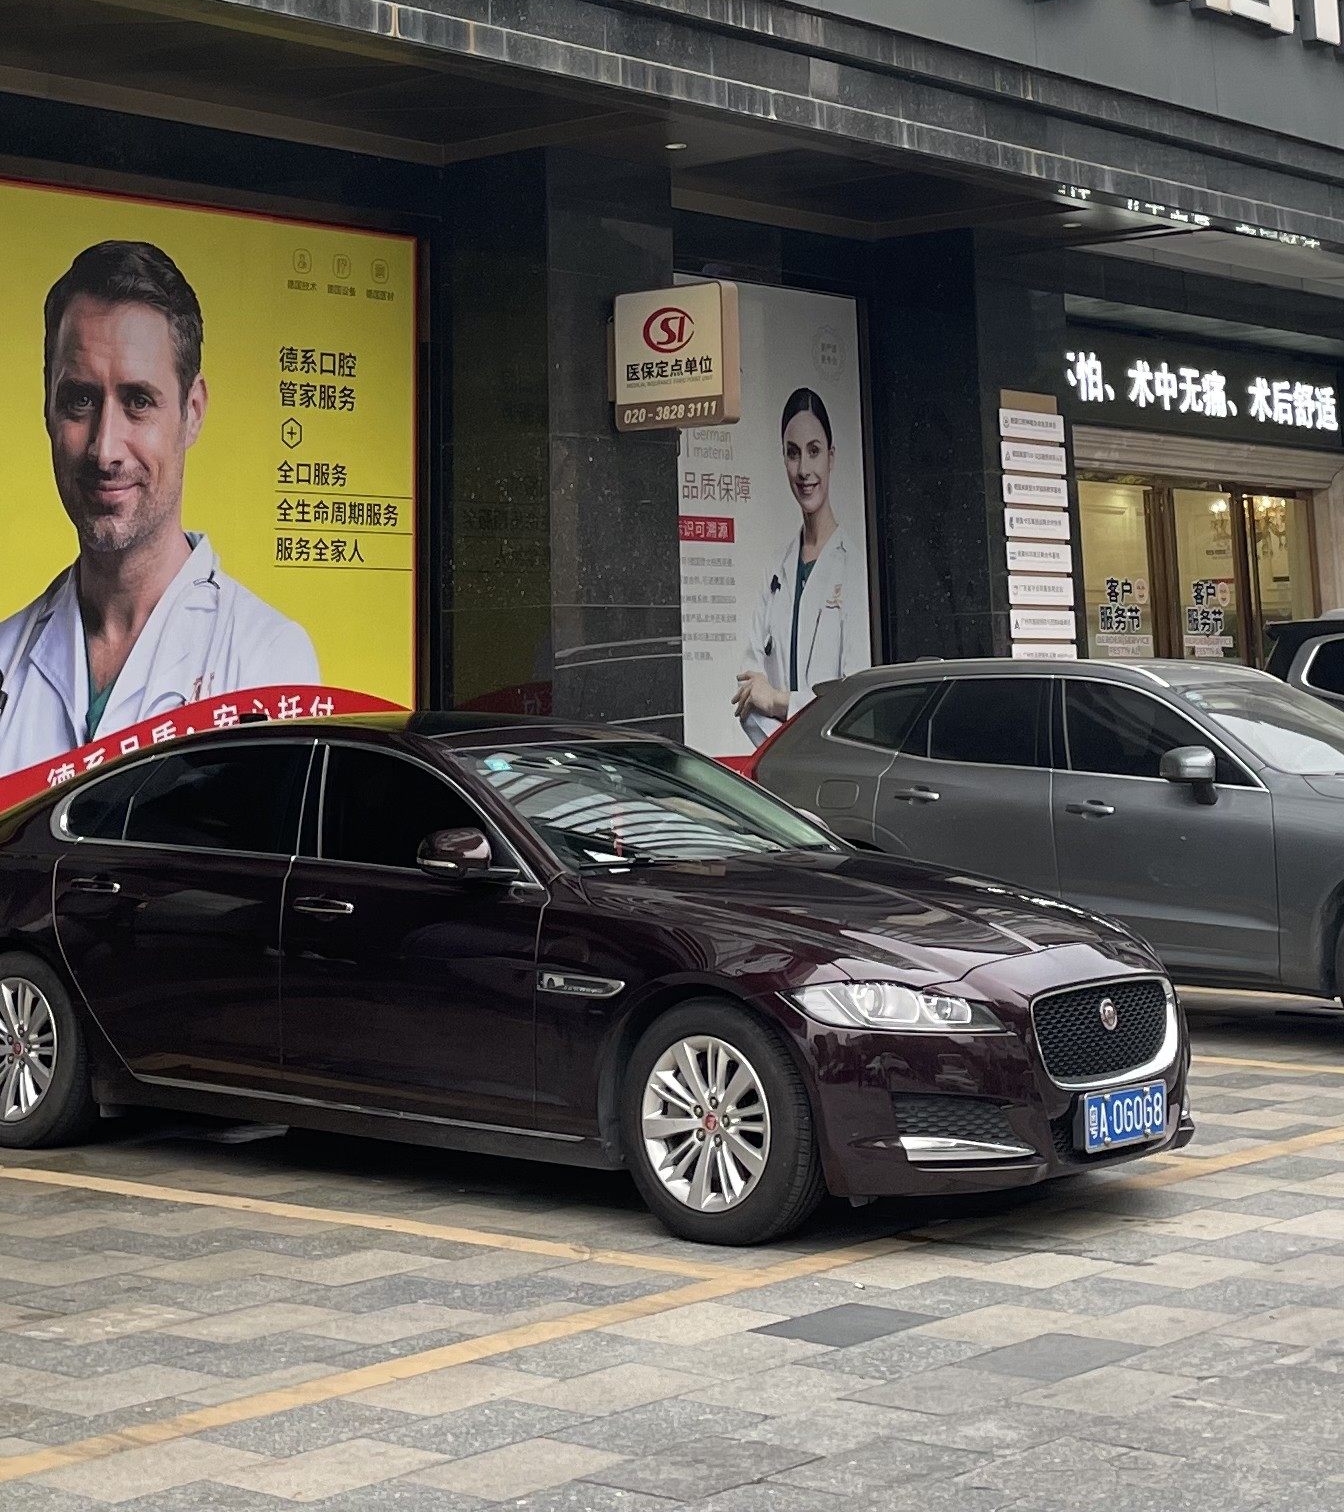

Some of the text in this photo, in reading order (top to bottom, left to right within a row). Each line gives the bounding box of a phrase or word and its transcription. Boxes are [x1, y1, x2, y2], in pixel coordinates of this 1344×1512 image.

[278, 345, 358, 378] 德系口腔
[626, 355, 713, 381] 医保定点单位
[278, 381, 357, 413] 管家服务
[1066, 351, 1340, 431] 怕、术中无痛、术后舒适
[693, 429, 732, 443] German
[693, 447, 734, 460] material
[277, 459, 348, 489] 全口服务
[682, 472, 752, 503] 品质保障
[276, 496, 400, 528] 全生命周期服务
[275, 535, 365, 565] 服务全家人
[1106, 578, 1133, 604] 客户
[1193, 581, 1216, 606] 客户
[1100, 605, 1141, 632] 服务节
[1187, 608, 1223, 635] 服务节
